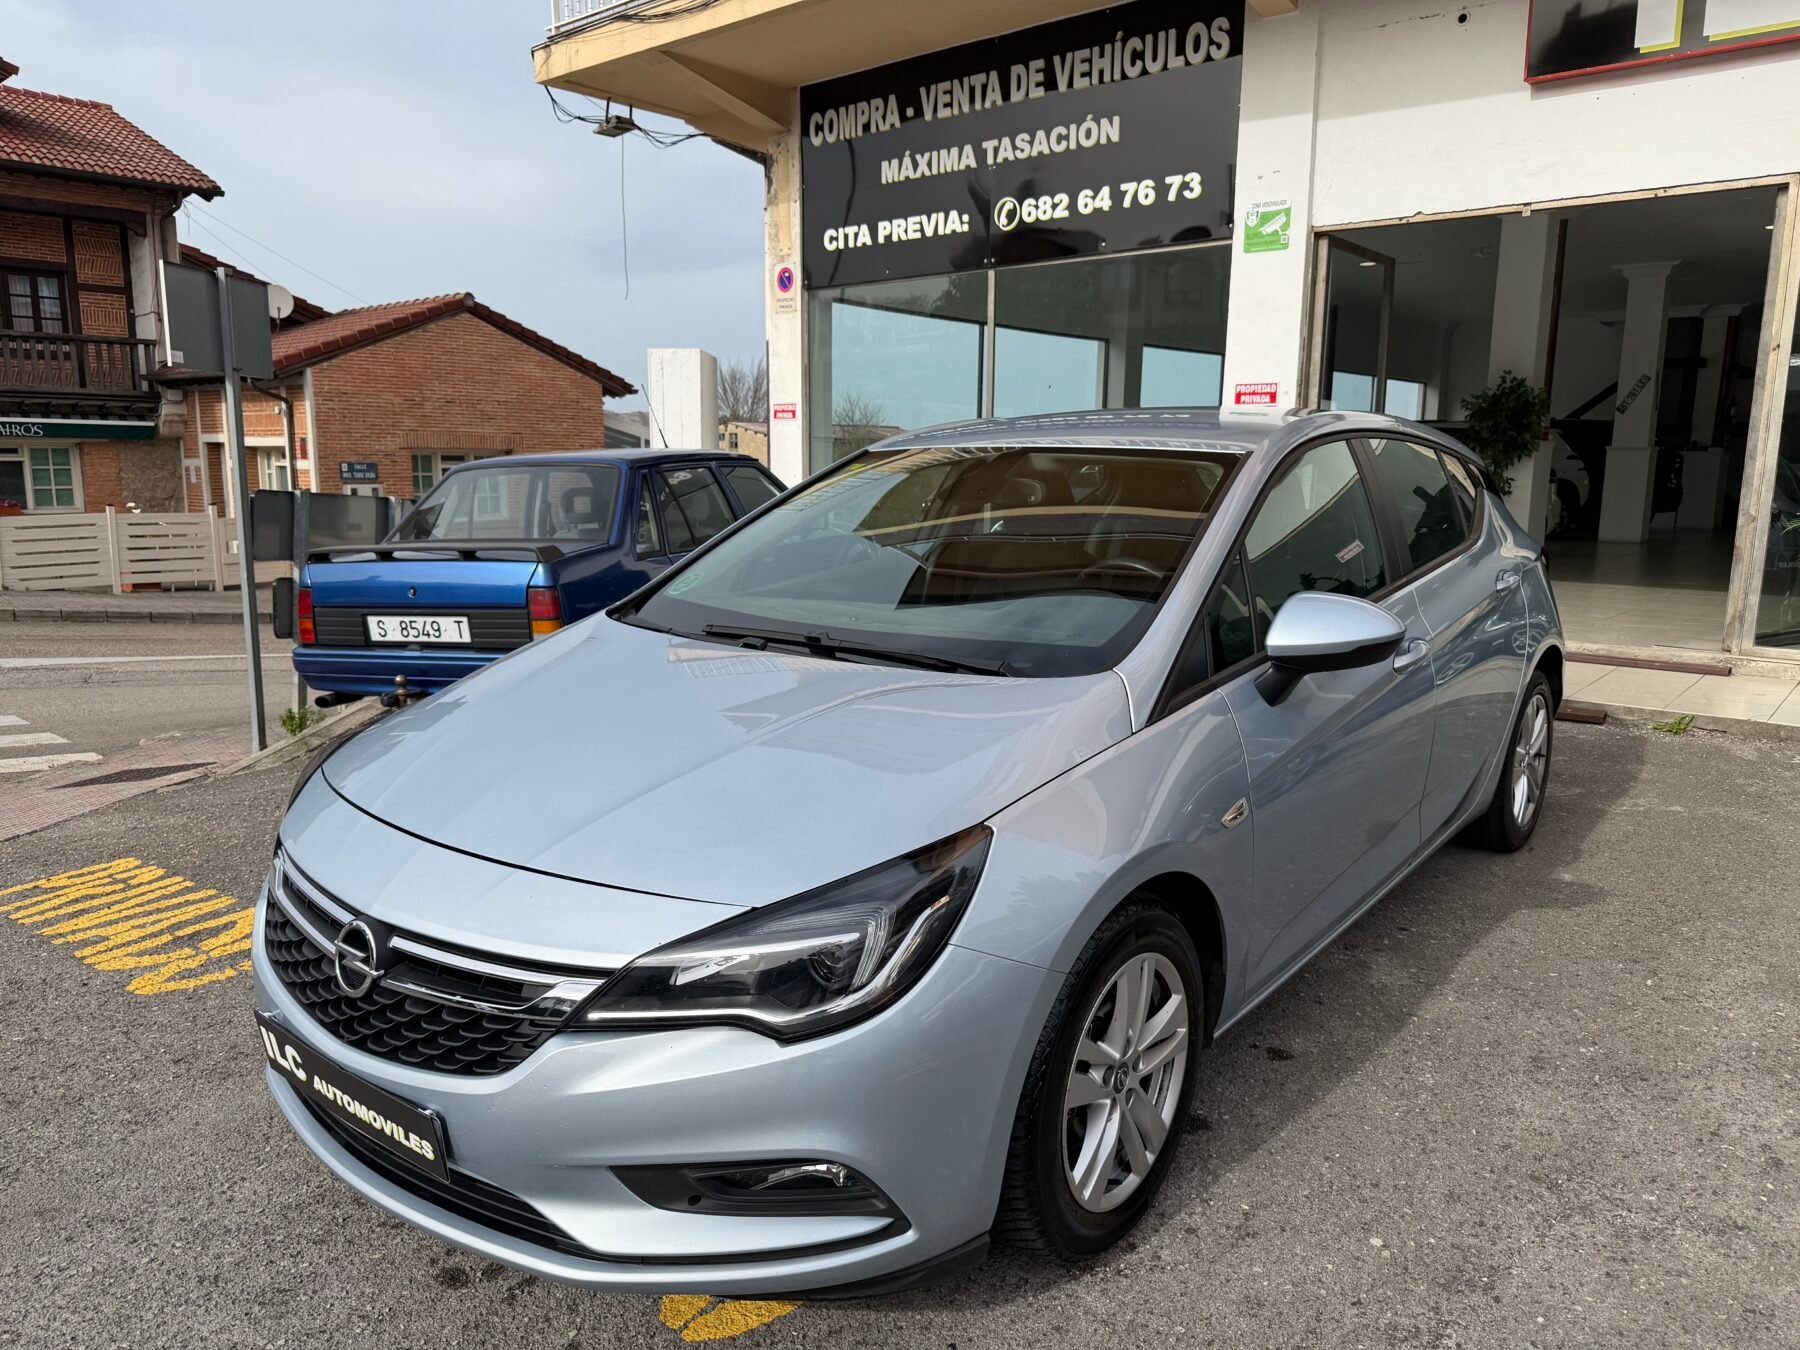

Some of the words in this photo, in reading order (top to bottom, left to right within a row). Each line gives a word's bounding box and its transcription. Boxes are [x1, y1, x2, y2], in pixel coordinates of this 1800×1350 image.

[809, 94, 902, 147] COMPRA
[919, 70, 1003, 122] VENTA
[1010, 58, 1046, 104] DE
[1053, 16, 1231, 93] VEHÍCULOS
[881, 144, 978, 185] MÁXIMA
[982, 114, 1121, 166] TASACIÓN
[823, 225, 873, 252] CITA
[877, 209, 970, 245] PREVIA:
[1021, 192, 1070, 224] 682
[1077, 185, 1113, 215] 64
[1120, 179, 1157, 208] 76
[1165, 171, 1203, 202] 73
[1236, 383, 1277, 393] PROPIEDAD
[1240, 394, 1270, 404] PRIVADA
[376, 620, 388, 638] S
[399, 620, 442, 639] 8549
[453, 620, 464, 639] T
[260, 1025, 307, 1082] ILC
[313, 1074, 436, 1162] AUTOMOVILES
